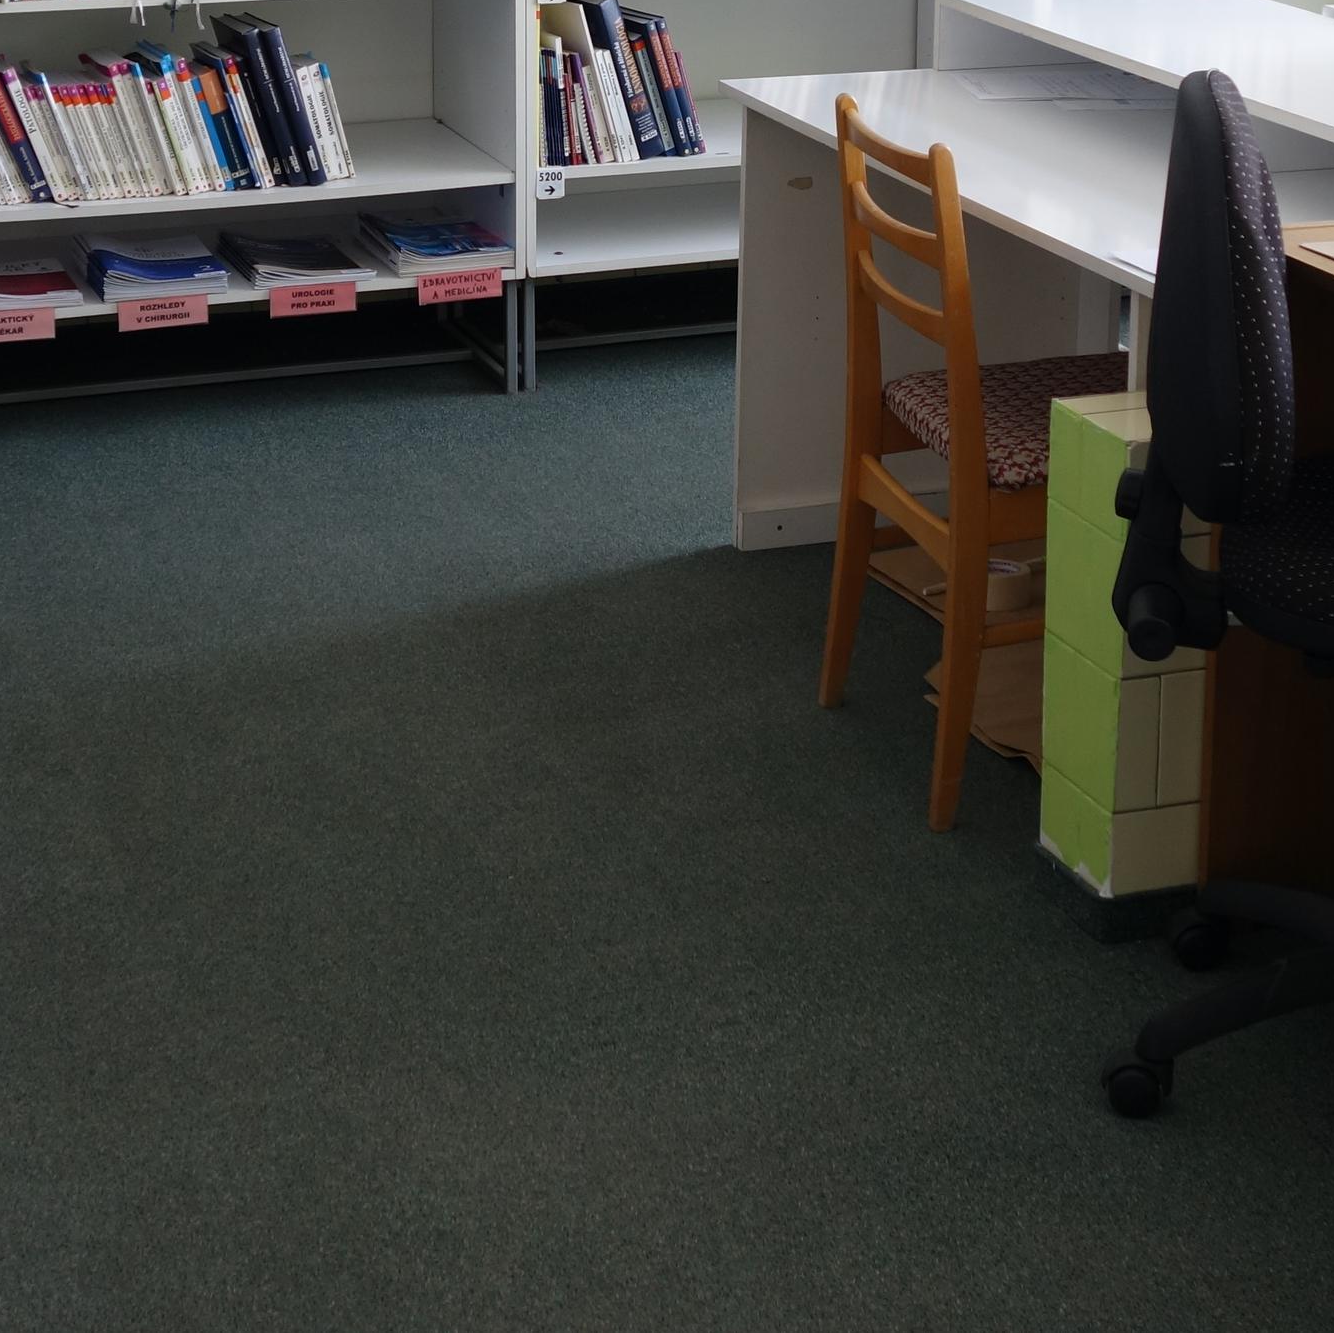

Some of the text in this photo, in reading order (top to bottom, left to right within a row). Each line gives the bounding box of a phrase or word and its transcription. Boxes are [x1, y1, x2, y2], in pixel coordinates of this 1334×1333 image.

[14, 89, 37, 133] PATOLOGIE
[306, 93, 323, 139] SOMATOLOGIE
[318, 90, 335, 136] SOMATOLOGIE
[538, 172, 563, 182] 5200
[292, 289, 335, 298] UROLOGIE
[432, 290, 438, 300] A
[139, 301, 185, 312] ROZHLEDY
[291, 299, 335, 309] PRO PRAXI
[145, 312, 190, 322] CHIRURGII
